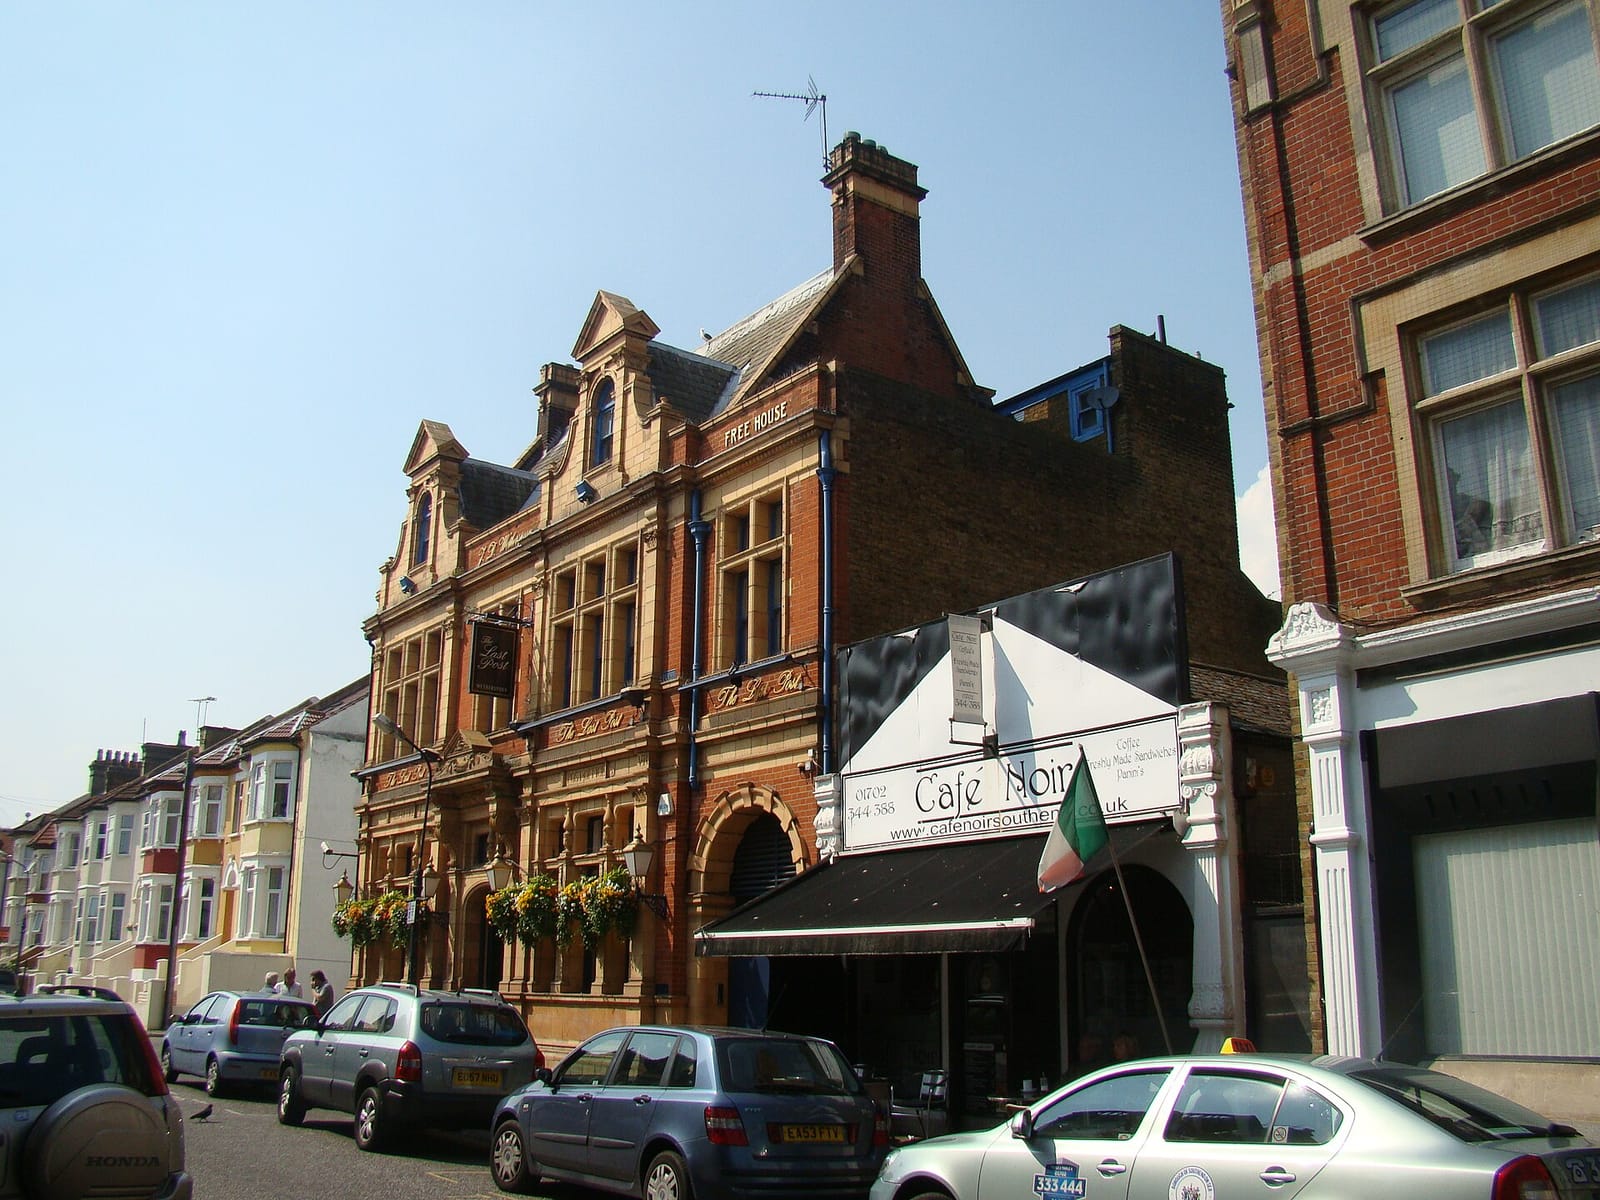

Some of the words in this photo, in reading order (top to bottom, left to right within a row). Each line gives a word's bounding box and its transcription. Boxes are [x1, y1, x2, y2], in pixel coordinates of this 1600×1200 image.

[724, 421, 750, 447] FREE
[754, 401, 787, 431] HOUSE
[480, 645, 508, 660] Last
[480, 657, 509, 670] Post
[714, 685, 738, 709] The
[773, 669, 802, 693] Post
[556, 721, 575, 742] The
[576, 716, 600, 736] Last
[601, 709, 624, 730] Post
[1116, 737, 1141, 751] Coffee
[1088, 756, 1111, 770] reshly
[1113, 753, 1131, 766] Made
[1134, 746, 1176, 762] Sandwiches
[855, 785, 887, 801] 01702
[915, 766, 984, 819] Café
[1006, 759, 1073, 801] Noir
[848, 805, 872, 819] 344
[873, 801, 896, 816] 388
[787, 1124, 816, 1139] EA53
[820, 1124, 839, 1139] FTY
[85, 1155, 160, 1168] HONDA
[1037, 1177, 1058, 1192] 333
[1060, 1179, 1083, 1194] 444
